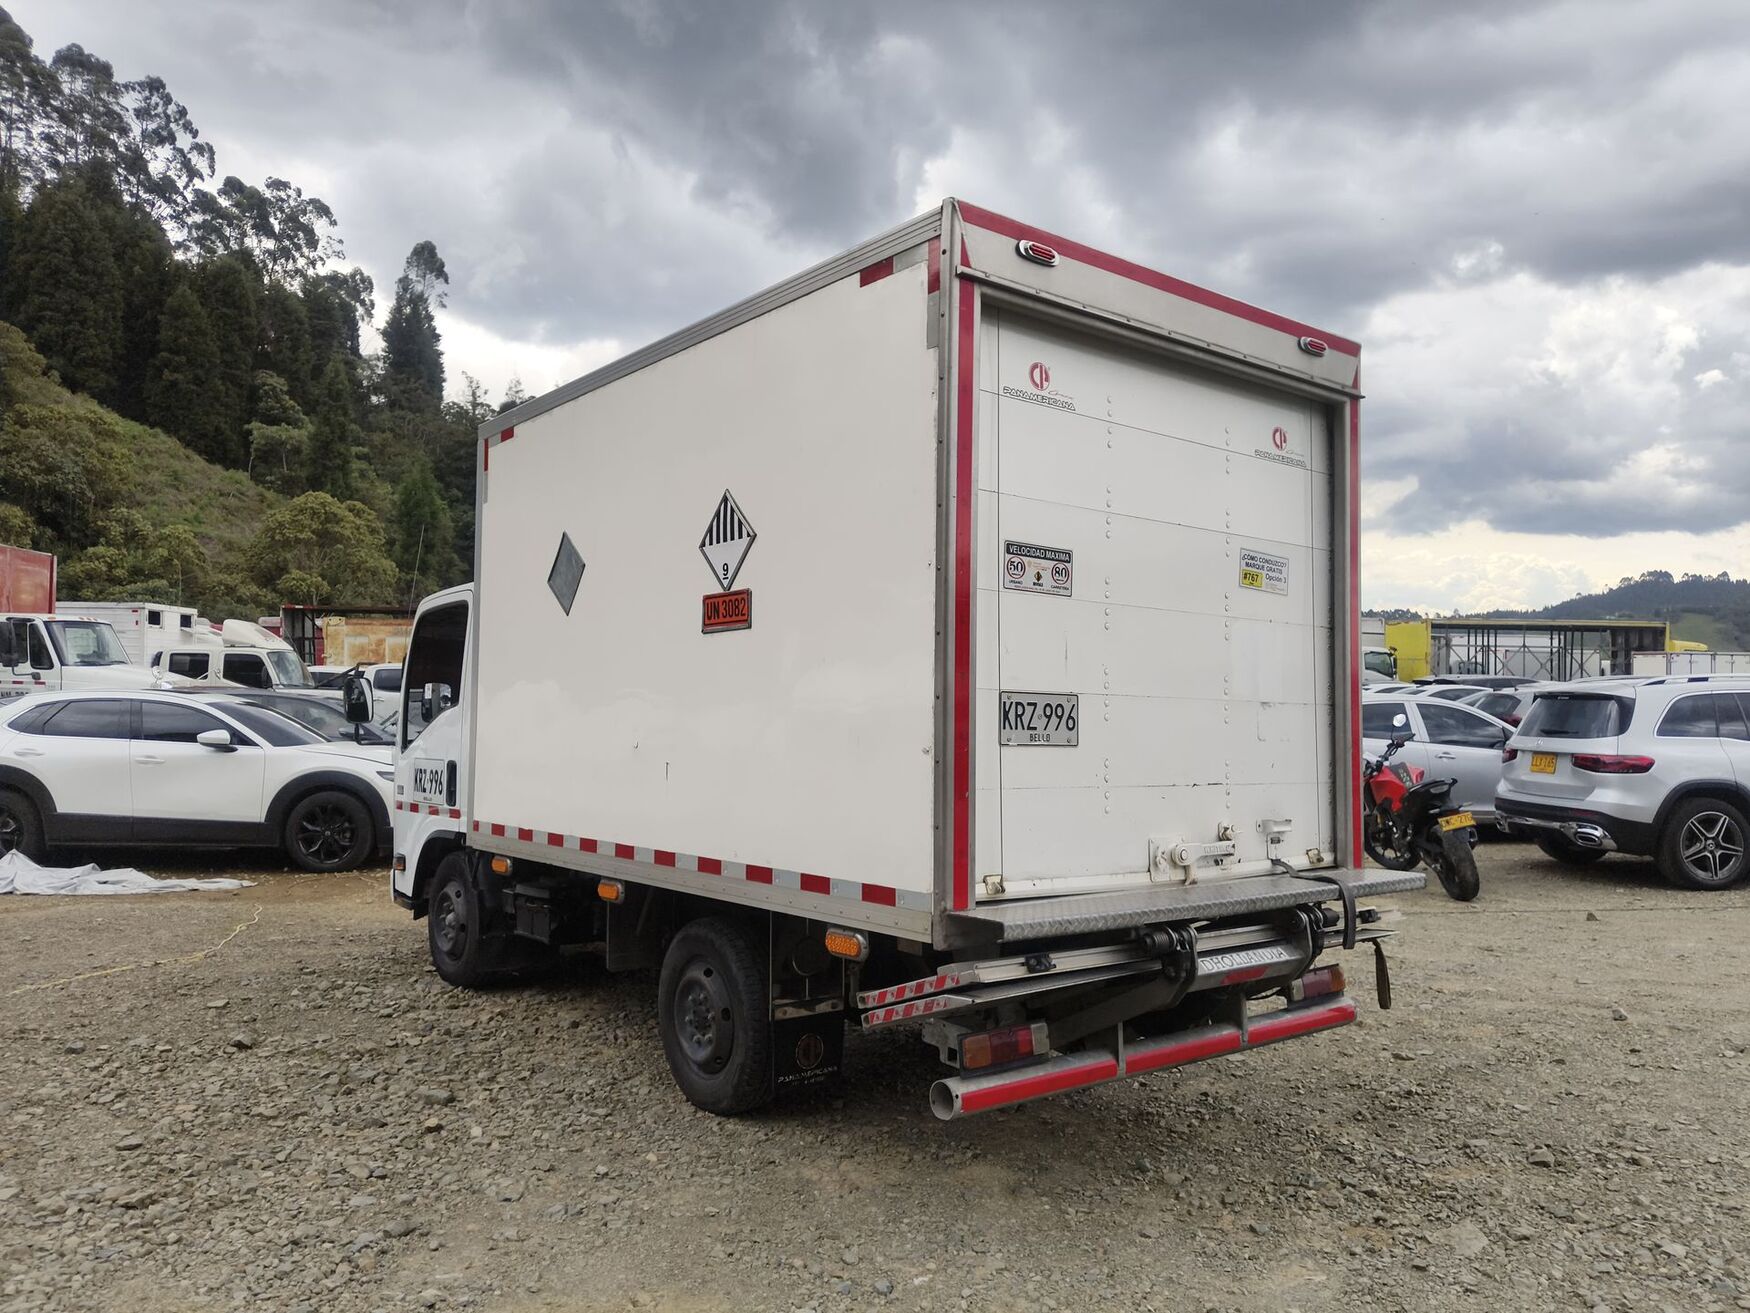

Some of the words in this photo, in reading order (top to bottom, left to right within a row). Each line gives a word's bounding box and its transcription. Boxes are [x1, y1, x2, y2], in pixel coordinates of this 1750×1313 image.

[1003, 386, 1076, 411] PANAMERICANA
[1009, 545, 1046, 558] VELOCIDAD
[1046, 551, 1070, 562] MAXIMA
[722, 563, 729, 577] 9
[1009, 561, 1024, 572] 50
[1055, 567, 1067, 578] 80
[1245, 561, 1265, 571] MARQUE
[1266, 566, 1283, 575] GRATIS
[706, 600, 720, 621] UN
[721, 597, 746, 618] 3082
[1029, 733, 1051, 742] BELLO
[1199, 948, 1289, 971] DHOLLANDIA
